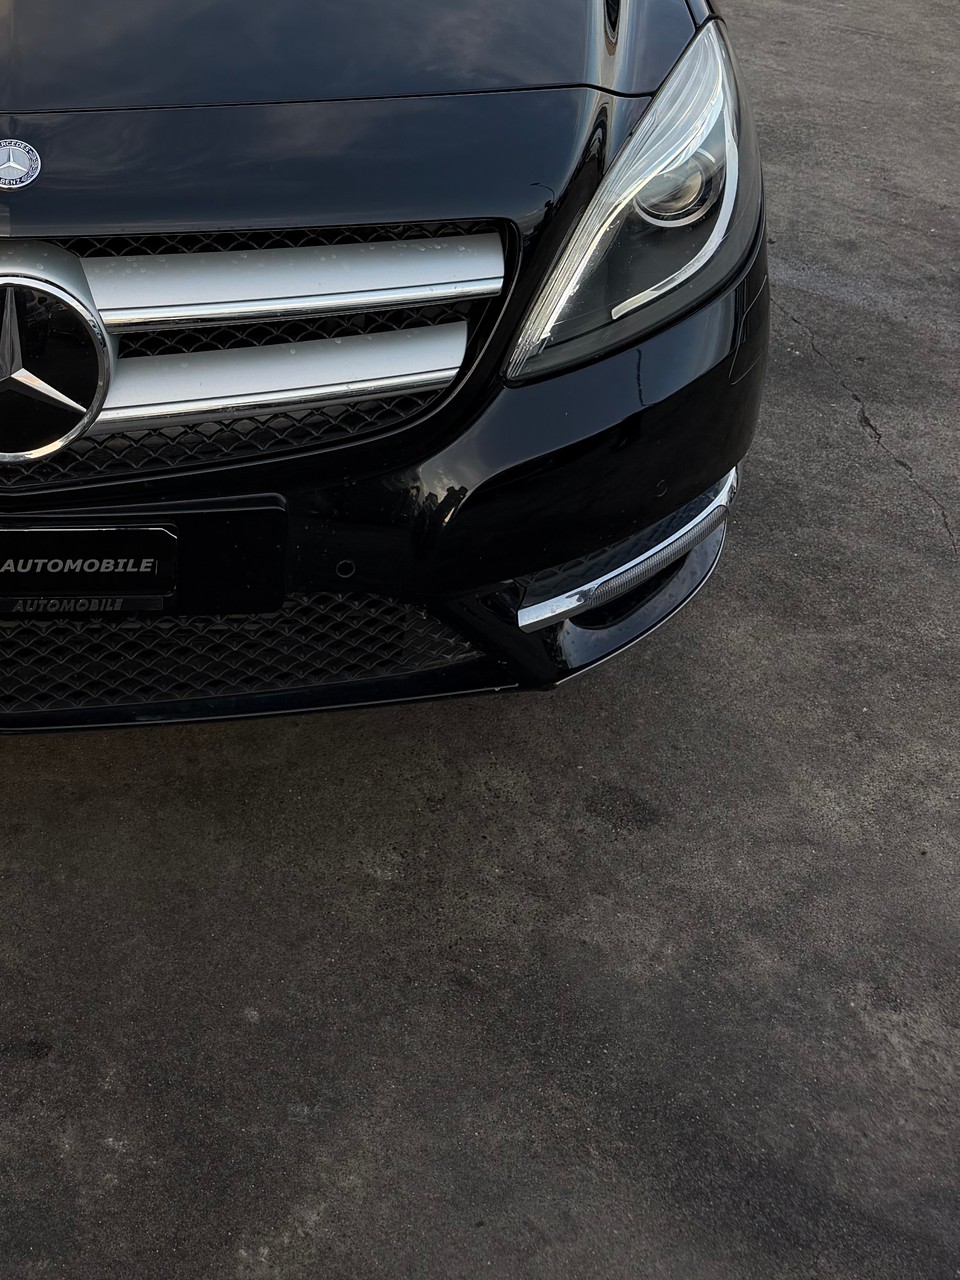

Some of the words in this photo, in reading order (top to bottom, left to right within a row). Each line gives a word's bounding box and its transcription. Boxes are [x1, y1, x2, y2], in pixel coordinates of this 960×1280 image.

[0, 178, 21, 186] BENZ
[0, 558, 155, 573] AUTOMOBILE
[12, 599, 124, 612] AUTOMOBILE
